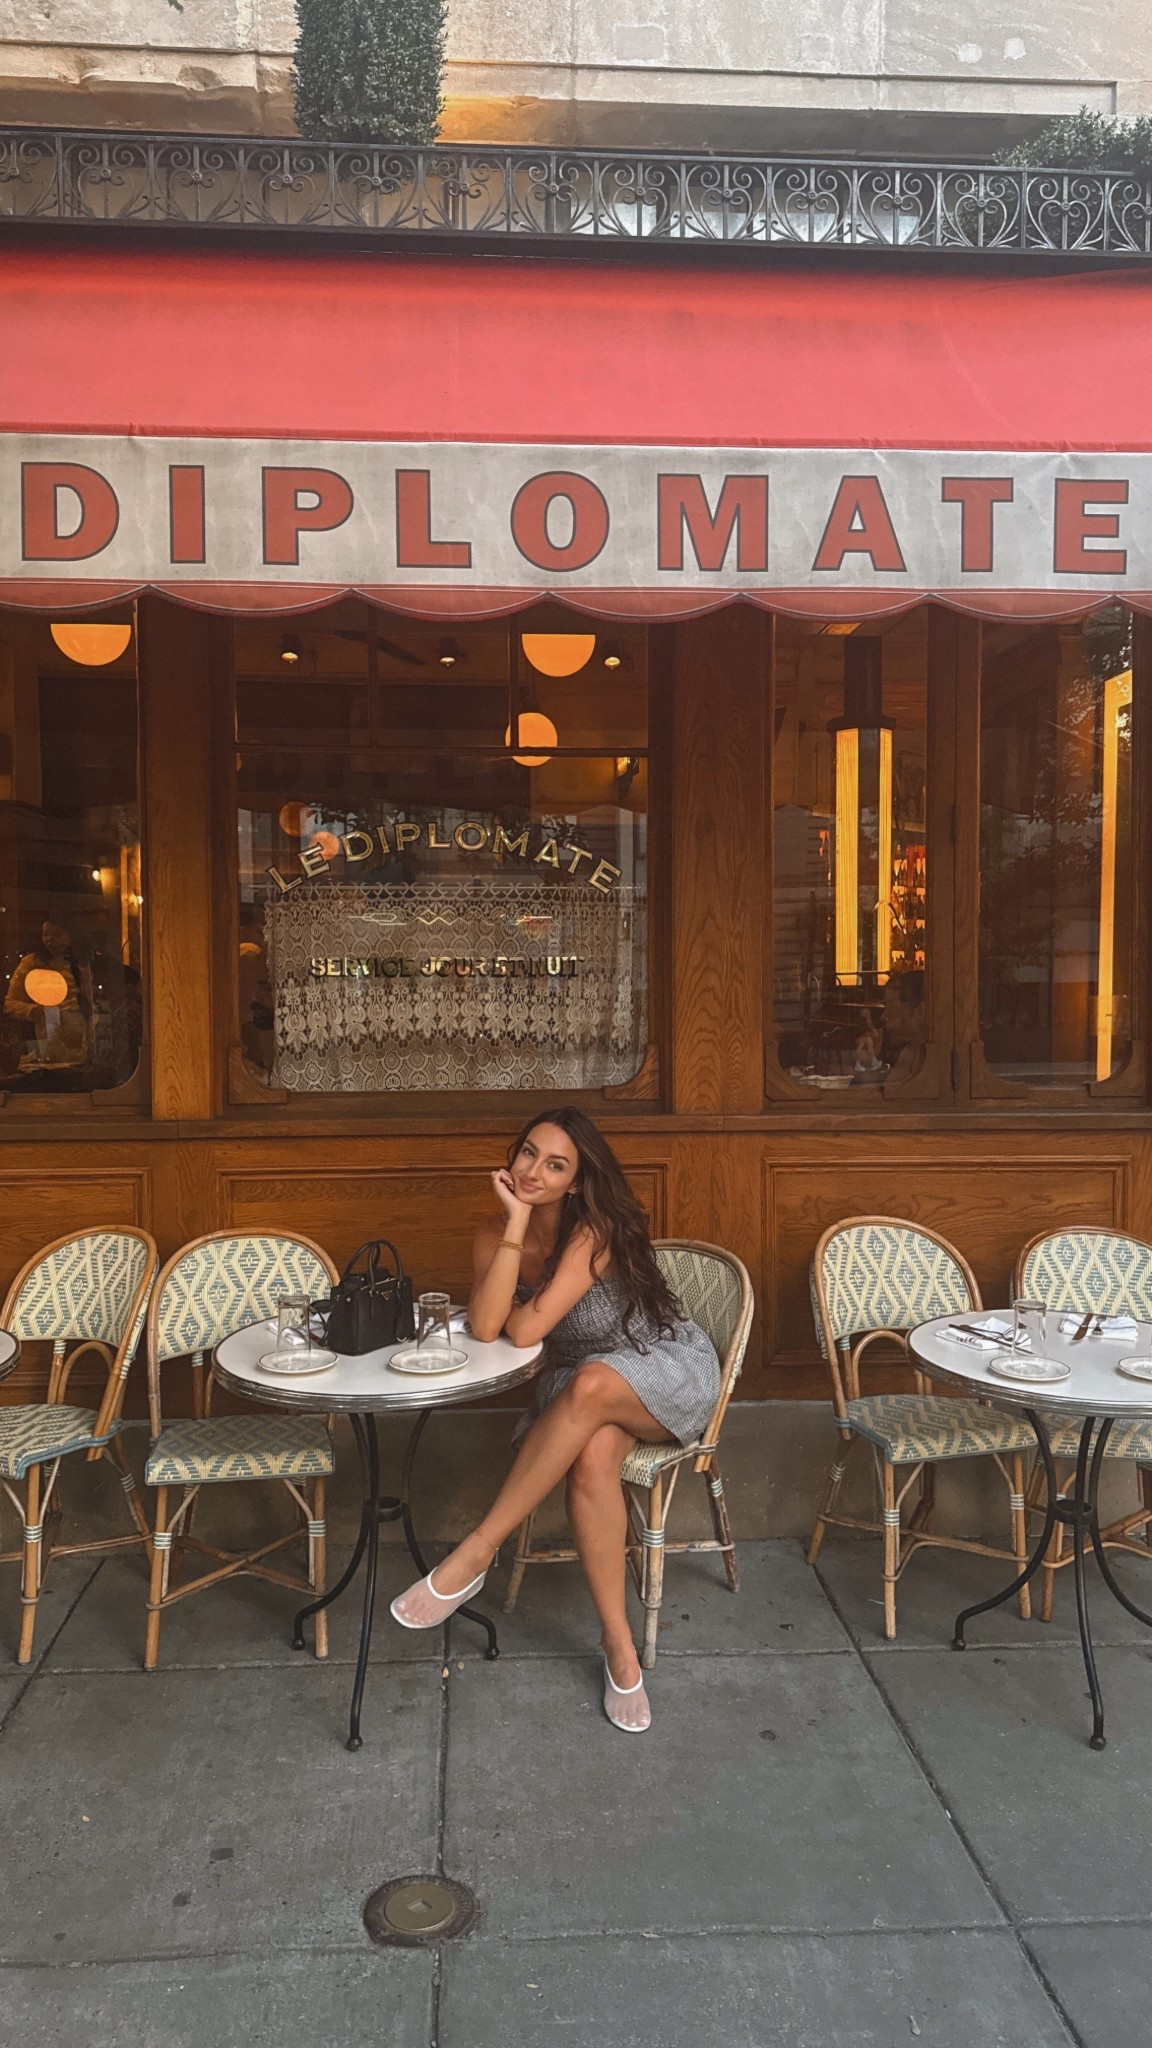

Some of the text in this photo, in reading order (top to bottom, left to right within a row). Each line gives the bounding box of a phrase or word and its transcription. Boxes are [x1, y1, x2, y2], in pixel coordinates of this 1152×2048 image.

[21, 461, 1130, 575] DIPLOMATE
[265, 820, 623, 896] LE DIPLOMATE
[309, 956, 416, 978] SERVICE
[420, 956, 489, 978] JOUR
[526, 956, 584, 978] NUIT
